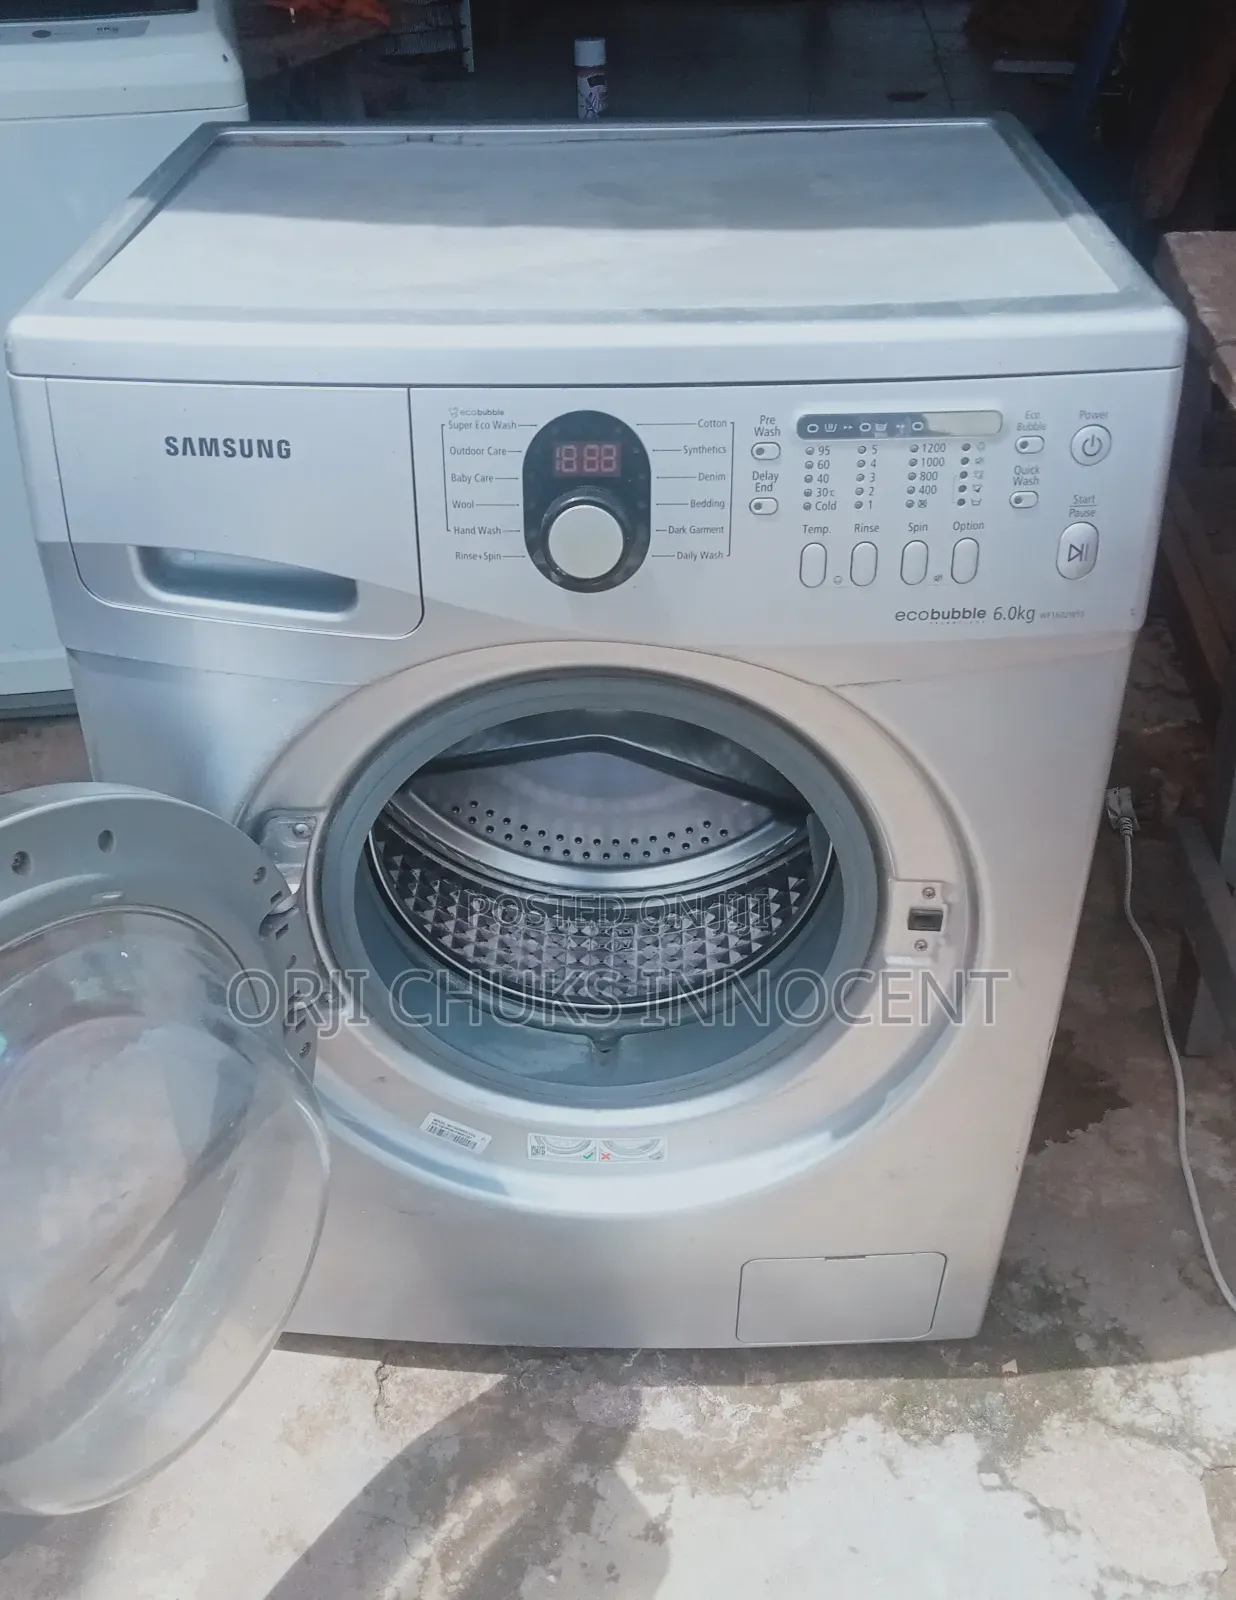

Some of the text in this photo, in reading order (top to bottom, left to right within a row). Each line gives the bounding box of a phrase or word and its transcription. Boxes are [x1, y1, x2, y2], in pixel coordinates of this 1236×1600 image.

[459, 408, 505, 416] ecobubble
[1025, 410, 1040, 420] Eco
[1079, 410, 1108, 420] Power
[448, 420, 517, 431] Super Eco Wash
[697, 418, 727, 429] Cotton
[759, 414, 776, 426] Pre
[754, 425, 781, 437] Wash
[1016, 422, 1047, 431] Bubble
[164, 435, 292, 460] SAMSUNG
[449, 446, 507, 456] Outdoor Care
[683, 445, 727, 456] Synthetics
[818, 445, 831, 456] 95
[871, 445, 878, 455] 5
[922, 443, 946, 454] 1200
[817, 459, 830, 470] 60
[870, 459, 877, 469] 4
[921, 457, 945, 468] 1000
[1013, 465, 1040, 475] Quick
[450, 473, 494, 484] Baby Care
[698, 472, 726, 482] Denim
[752, 470, 779, 483] Delay
[816, 473, 830, 484] 40
[869, 473, 876, 483] 3
[919, 471, 938, 482] 800
[1013, 476, 1040, 486] Wash
[755, 482, 773, 493] End
[868, 486, 875, 497] 2
[918, 485, 937, 495] 400
[452, 500, 474, 509] Wool
[690, 499, 725, 510] Bedding
[1073, 494, 1096, 504] Start
[815, 501, 837, 511] Cold
[867, 500, 873, 510] 1
[1069, 508, 1097, 518] Pause
[453, 526, 502, 535] Hand Wash
[668, 525, 725, 535] Dark Garment
[854, 523, 880, 533] Rinse
[908, 522, 929, 533] Spin
[952, 521, 985, 532] Option
[676, 551, 724, 562] Daily Wash
[895, 607, 987, 622] ecobubble
[993, 605, 1036, 624] 6.0kg
